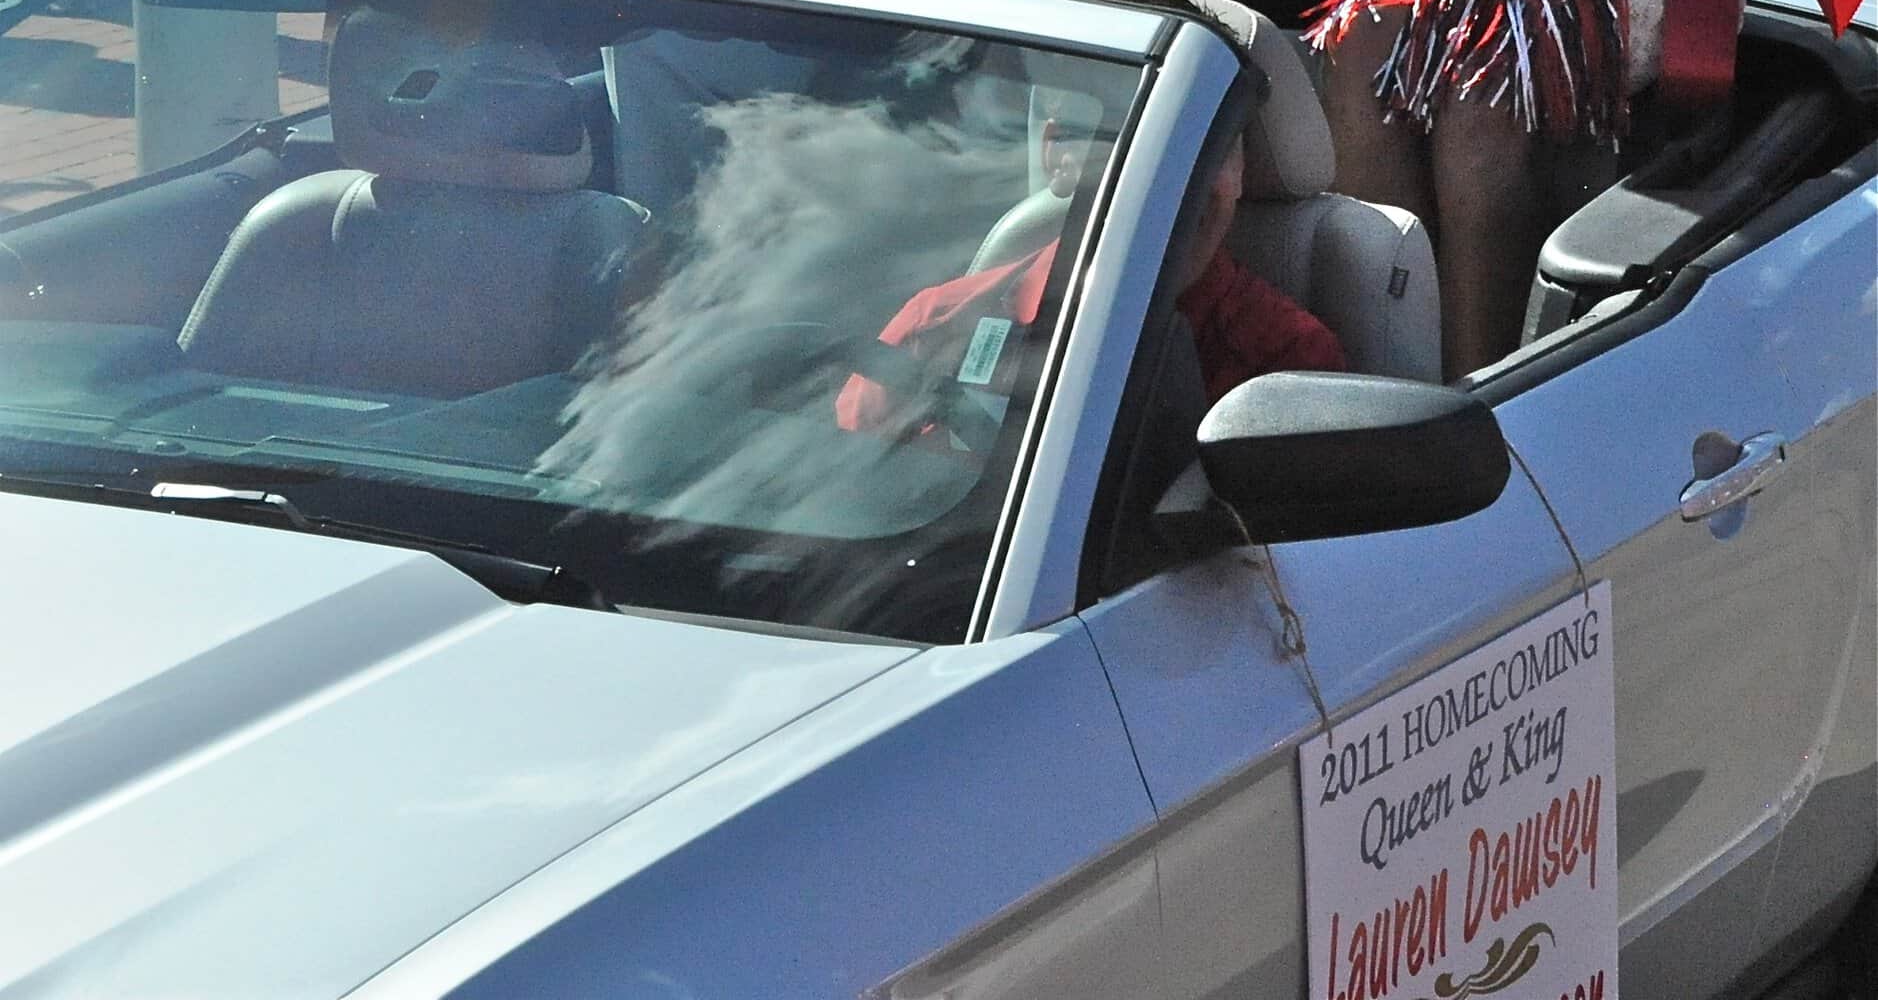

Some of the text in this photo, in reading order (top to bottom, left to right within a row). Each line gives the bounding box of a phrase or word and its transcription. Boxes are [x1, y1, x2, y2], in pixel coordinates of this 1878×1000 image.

[1319, 609, 1599, 807] 2011 HOMECOMING
[1360, 706, 1568, 870] Queen & King
[1328, 774, 1602, 1000] Lauren Dawsey
